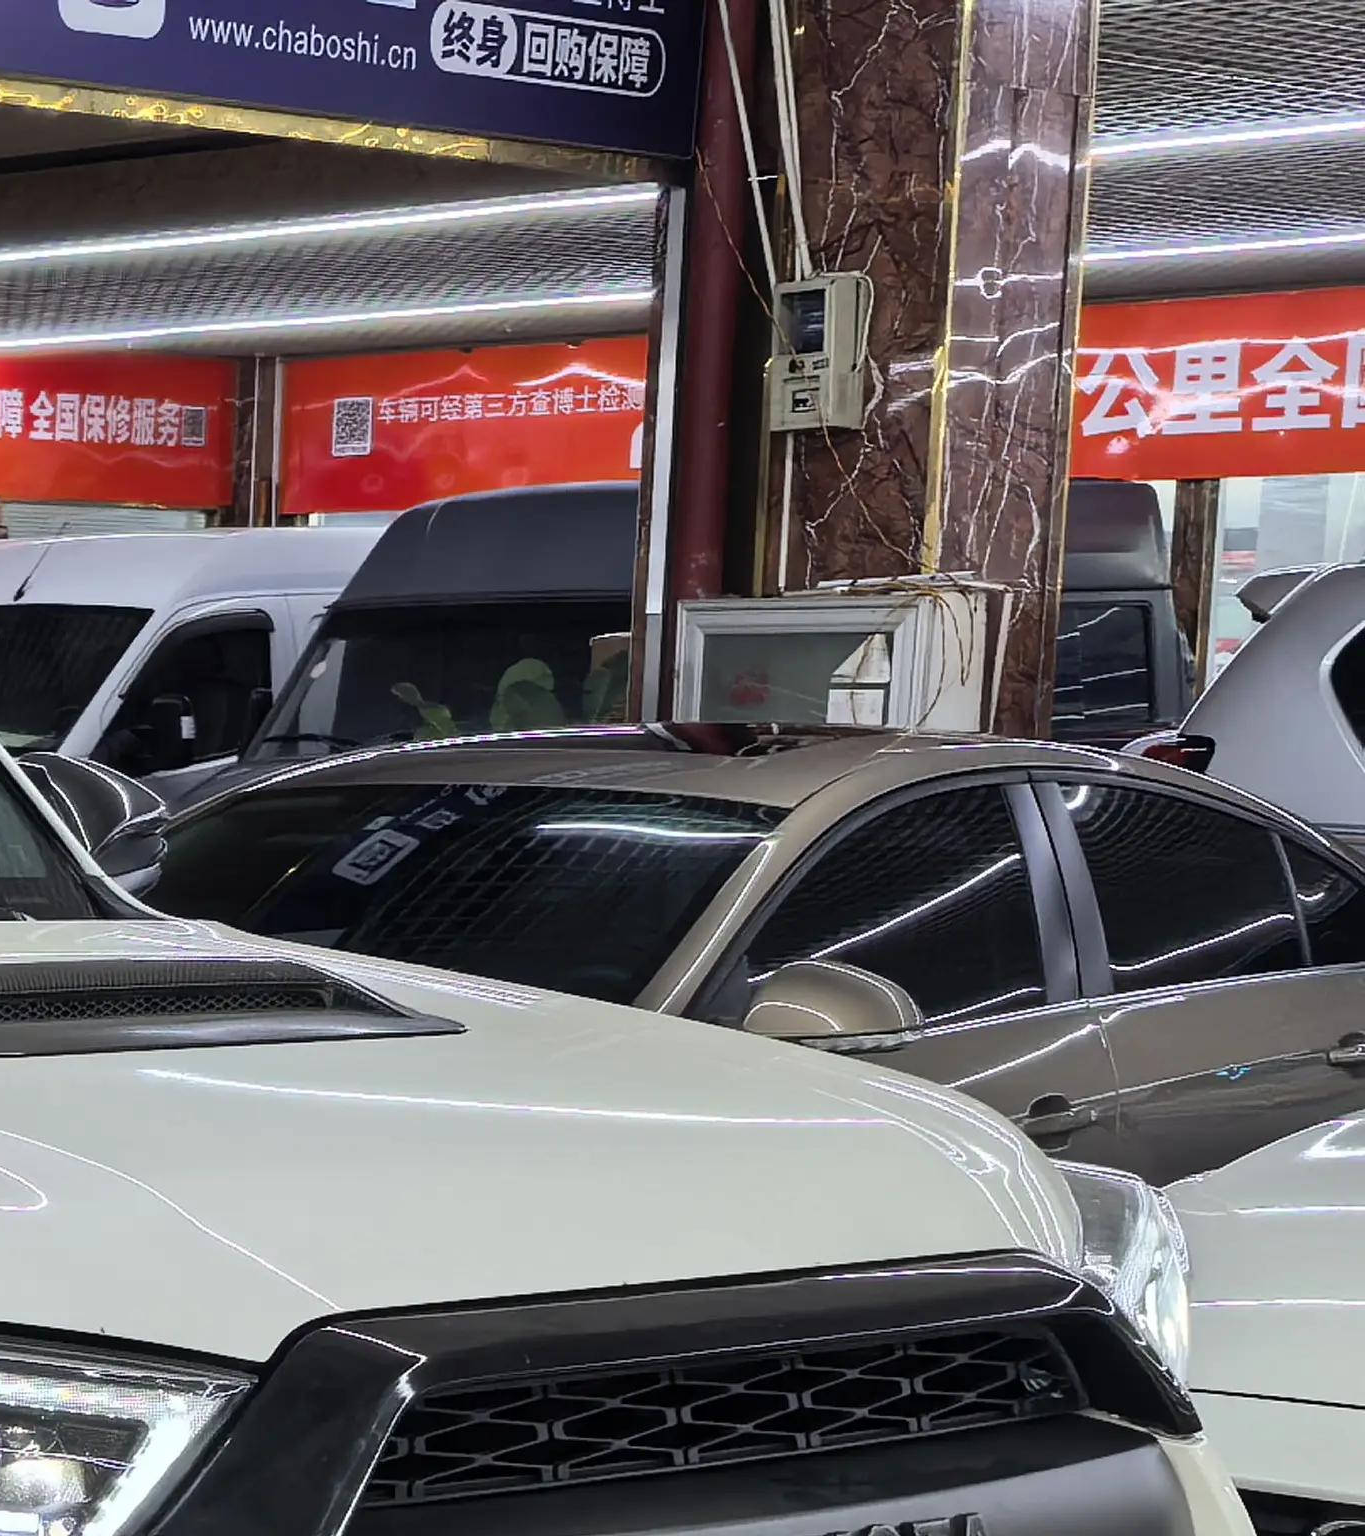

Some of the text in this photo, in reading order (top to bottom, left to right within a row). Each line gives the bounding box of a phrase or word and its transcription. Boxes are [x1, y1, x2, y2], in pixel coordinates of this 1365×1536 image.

[189, 16, 416, 70] www.chaboshi.cn
[441, 9, 650, 88] 终身 回购保障
[29, 391, 181, 447] 全国保修服务
